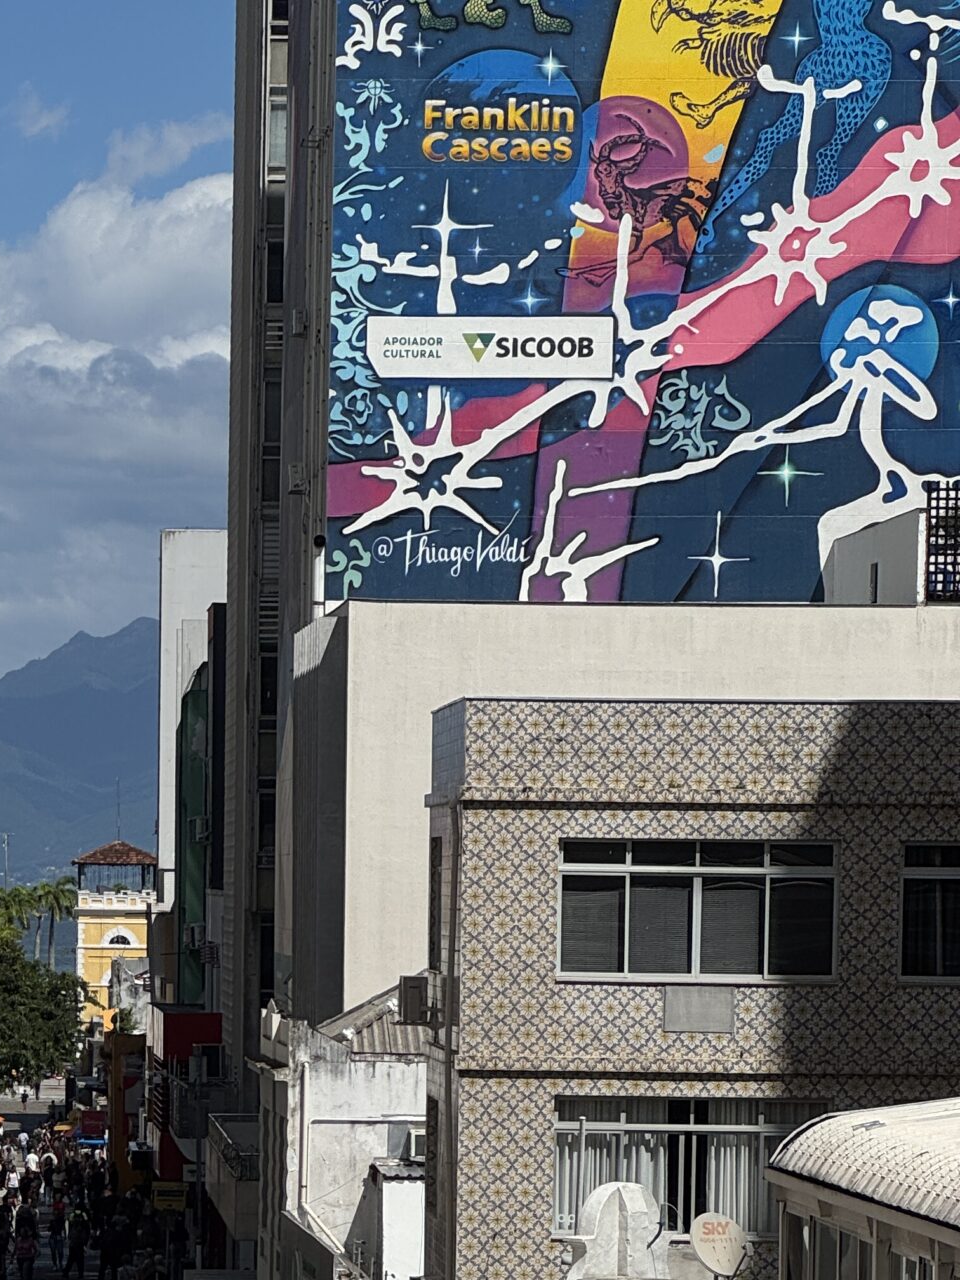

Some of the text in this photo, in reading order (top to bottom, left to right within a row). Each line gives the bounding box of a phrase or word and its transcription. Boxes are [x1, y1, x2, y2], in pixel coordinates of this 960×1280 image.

[424, 97, 574, 132] Franklin
[422, 131, 573, 162] Cascaes
[383, 336, 443, 346] APOIADOR
[495, 336, 594, 358] SICOOB
[383, 349, 442, 359] CULTURAL
[702, 1221, 730, 1236] SKY
